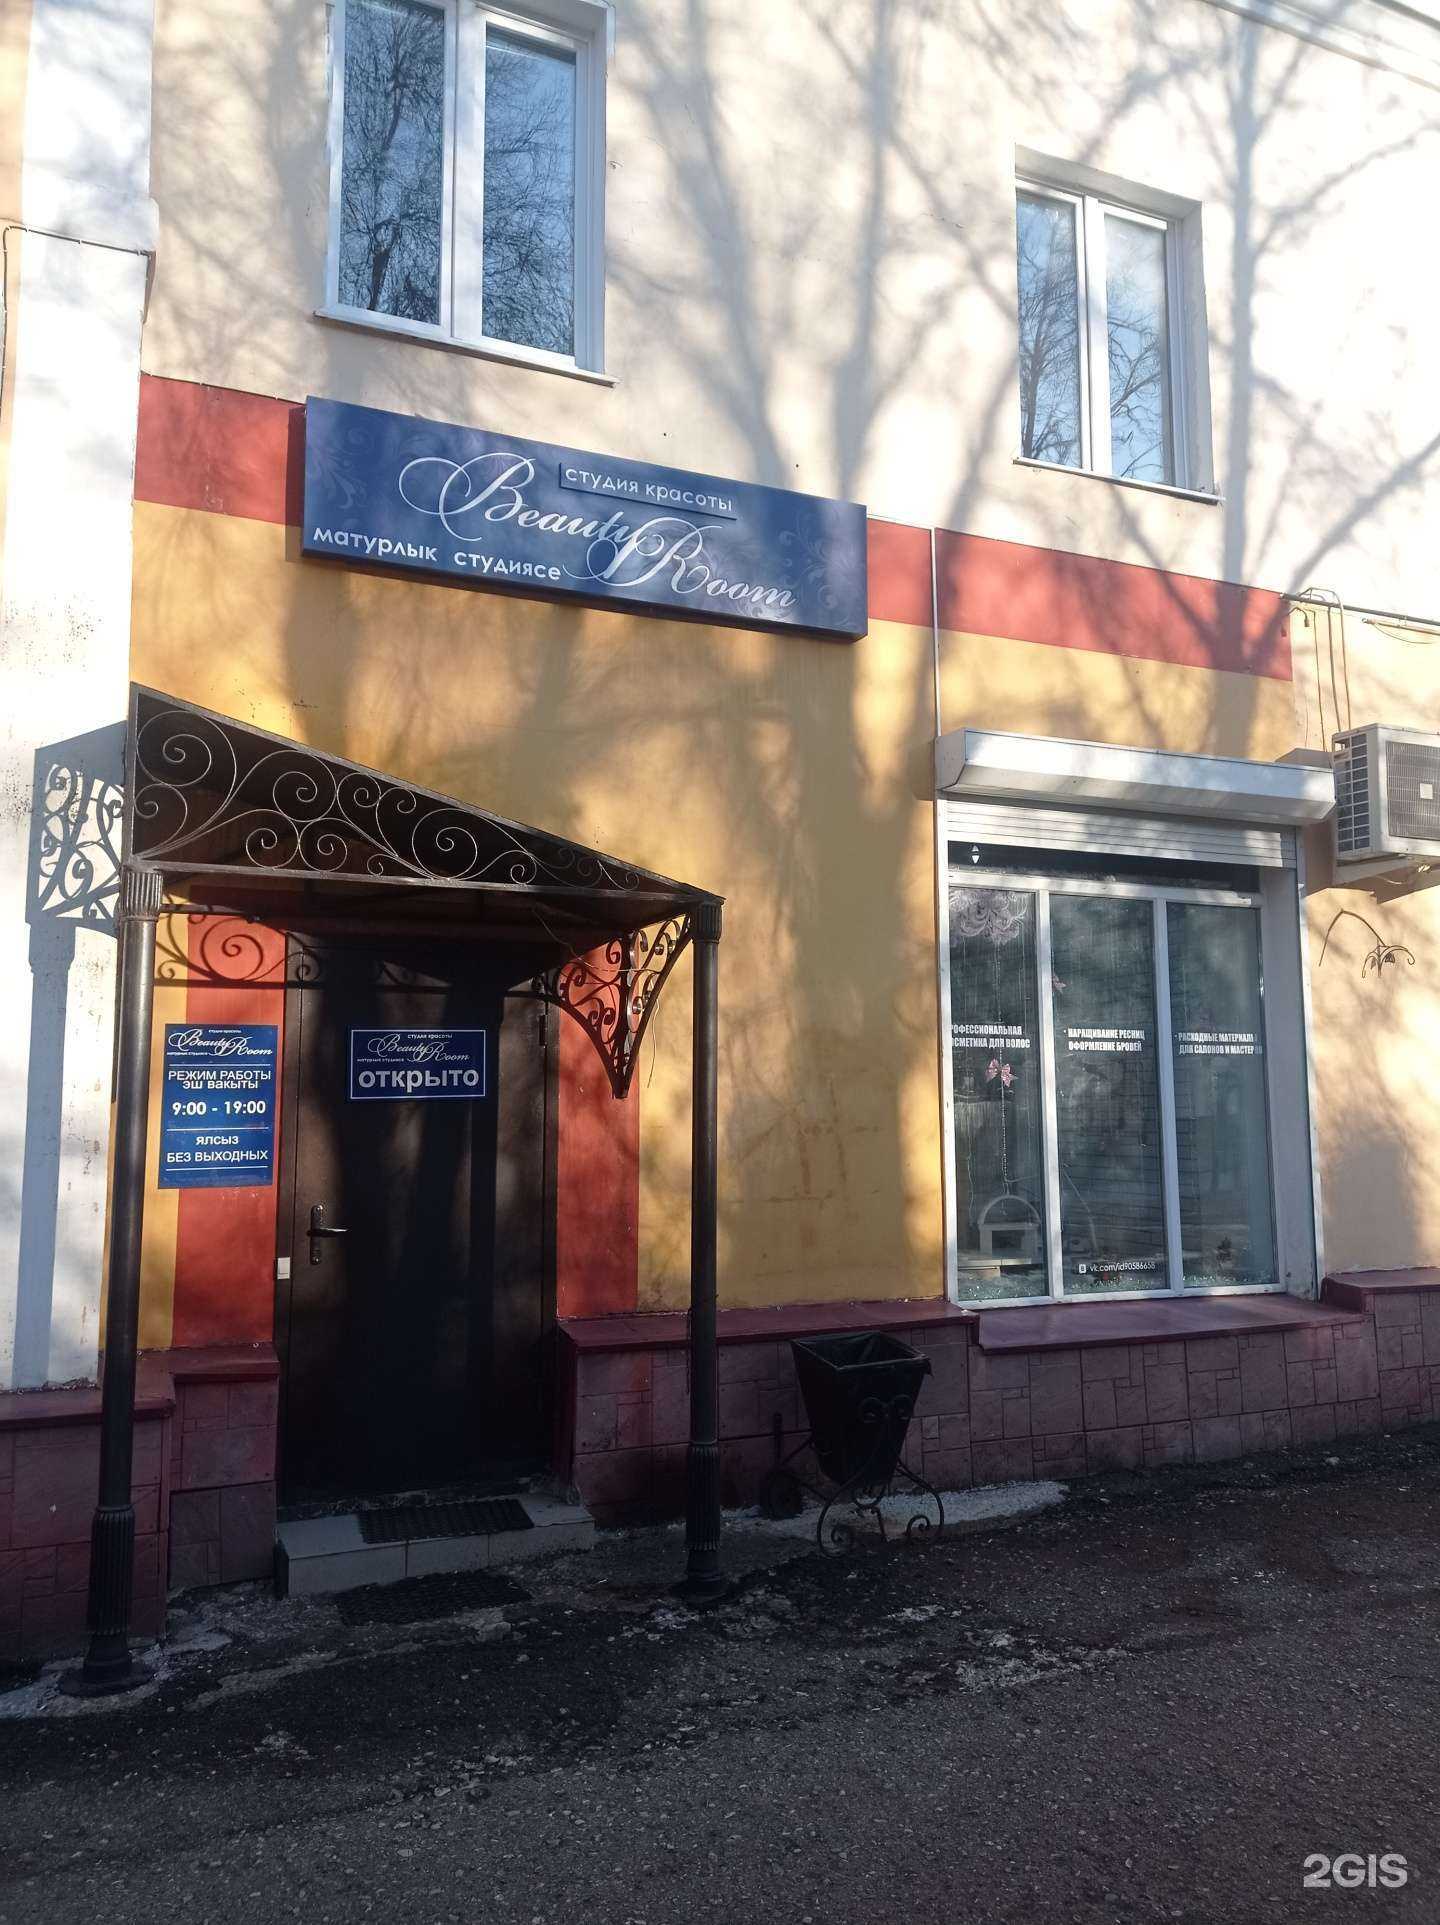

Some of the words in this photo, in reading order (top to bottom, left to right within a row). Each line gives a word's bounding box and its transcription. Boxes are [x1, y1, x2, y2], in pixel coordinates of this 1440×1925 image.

[565, 468, 638, 494] студия
[646, 484, 733, 513] красоты
[399, 452, 645, 579] Beauty
[587, 517, 797, 607] Room
[313, 528, 437, 562] матурлык
[454, 551, 561, 581] студиясе
[168, 1029, 229, 1056] Beauty
[214, 1037, 272, 1056] Room
[368, 1034, 428, 1061] Beauty
[409, 1042, 471, 1063] Room
[168, 1070, 217, 1081] РЕЖИМ
[220, 1070, 272, 1080] РАБОТЫ
[172, 1101, 207, 1116] 9:00
[224, 1100, 266, 1115] 19:00
[167, 1152, 191, 1163] БЕЗ
[194, 1150, 269, 1162] ВЫХОДНЫХ
